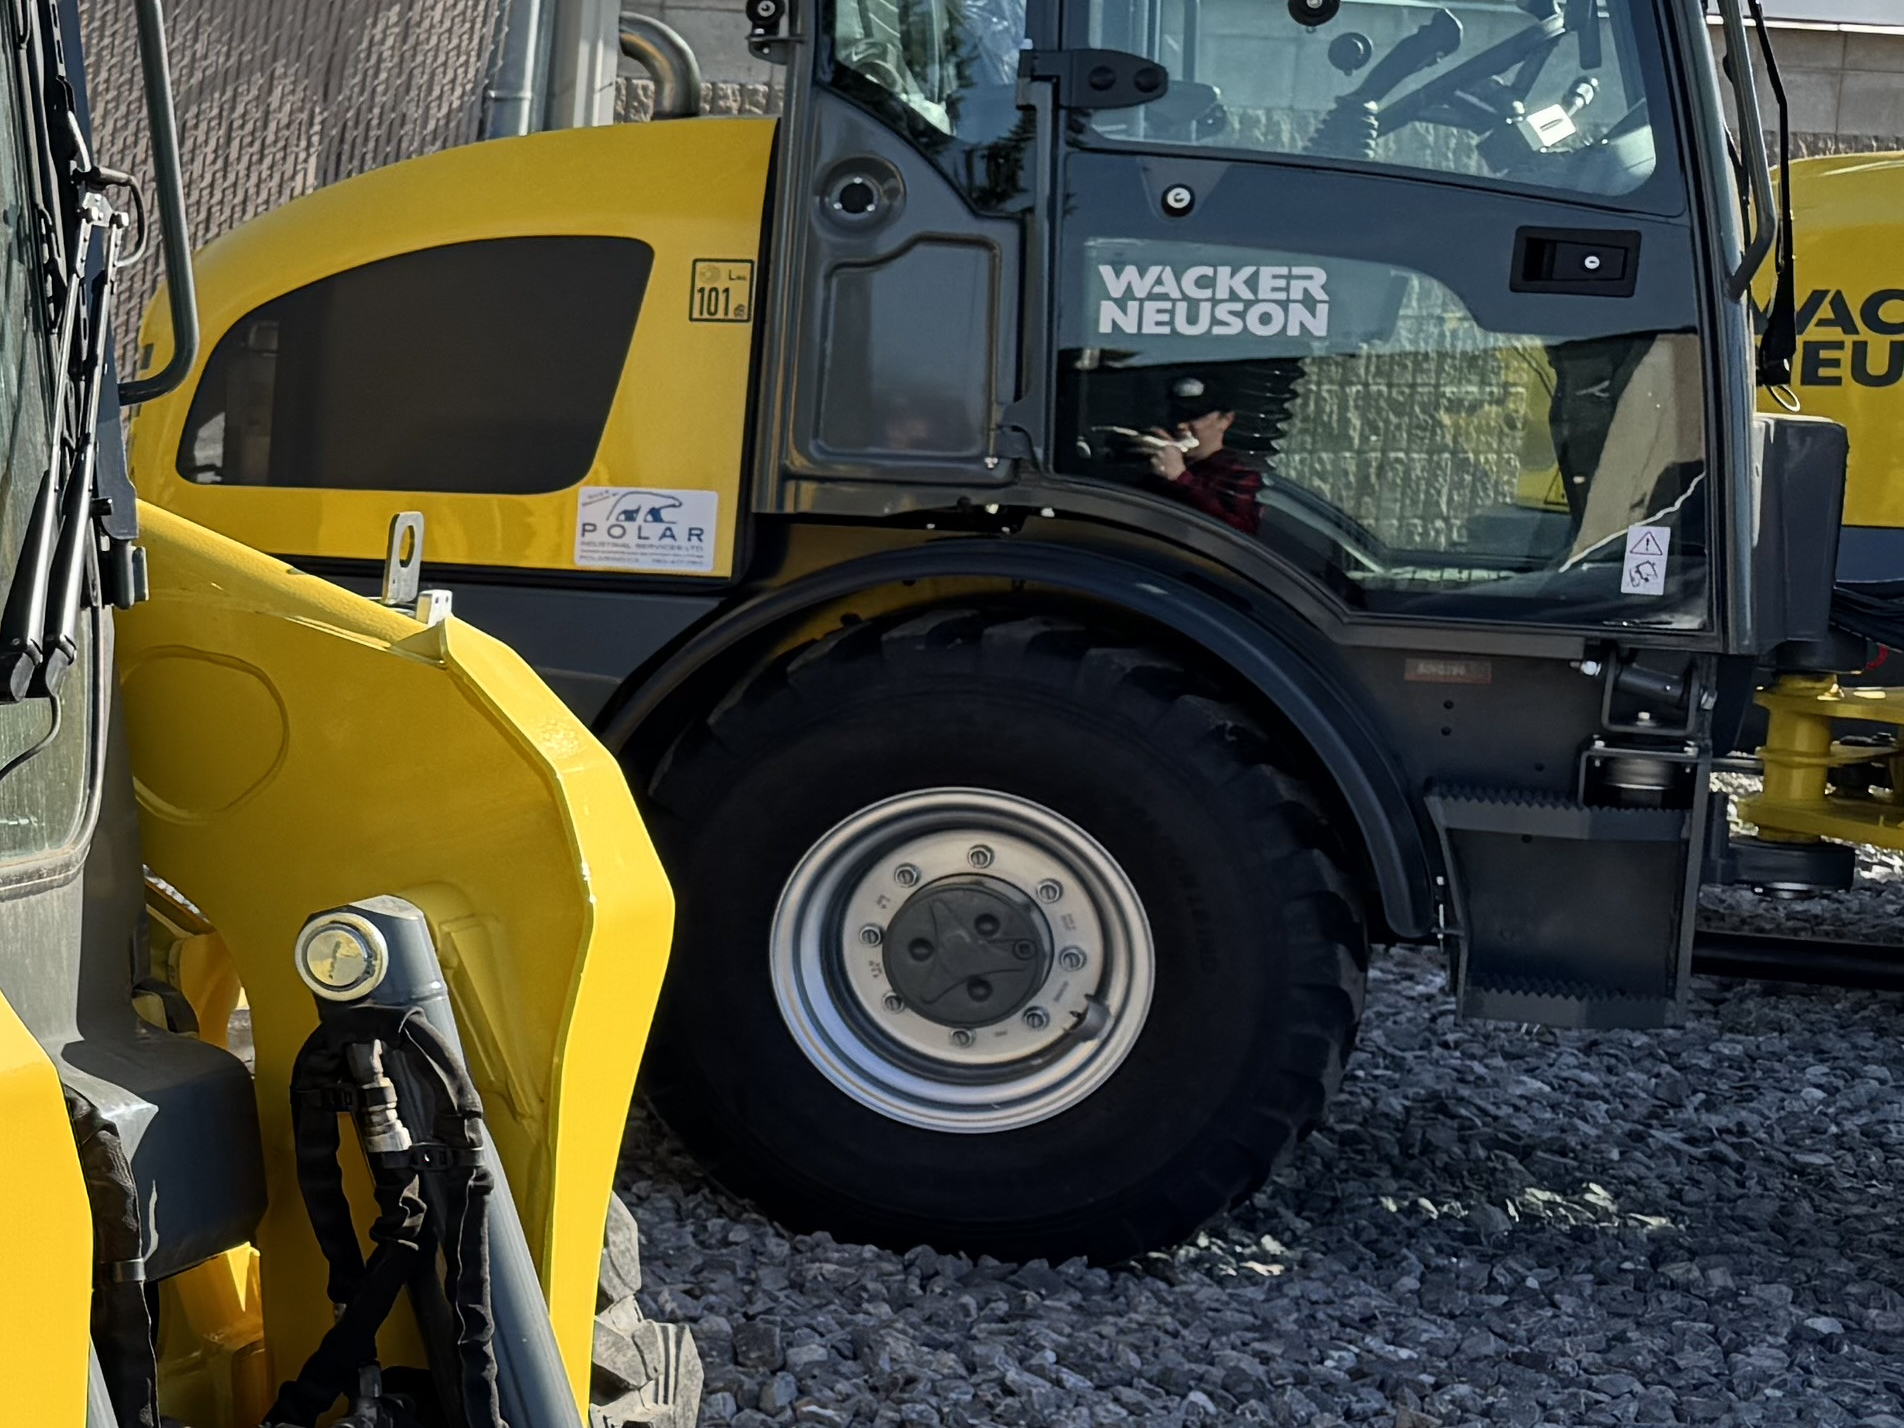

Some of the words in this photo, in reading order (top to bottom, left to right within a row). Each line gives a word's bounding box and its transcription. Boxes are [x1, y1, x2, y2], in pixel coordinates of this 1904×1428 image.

[1098, 264, 1330, 300] WACKER
[697, 286, 730, 317] 101
[1098, 300, 1329, 337] NEUSON
[581, 522, 705, 543] POLAR
